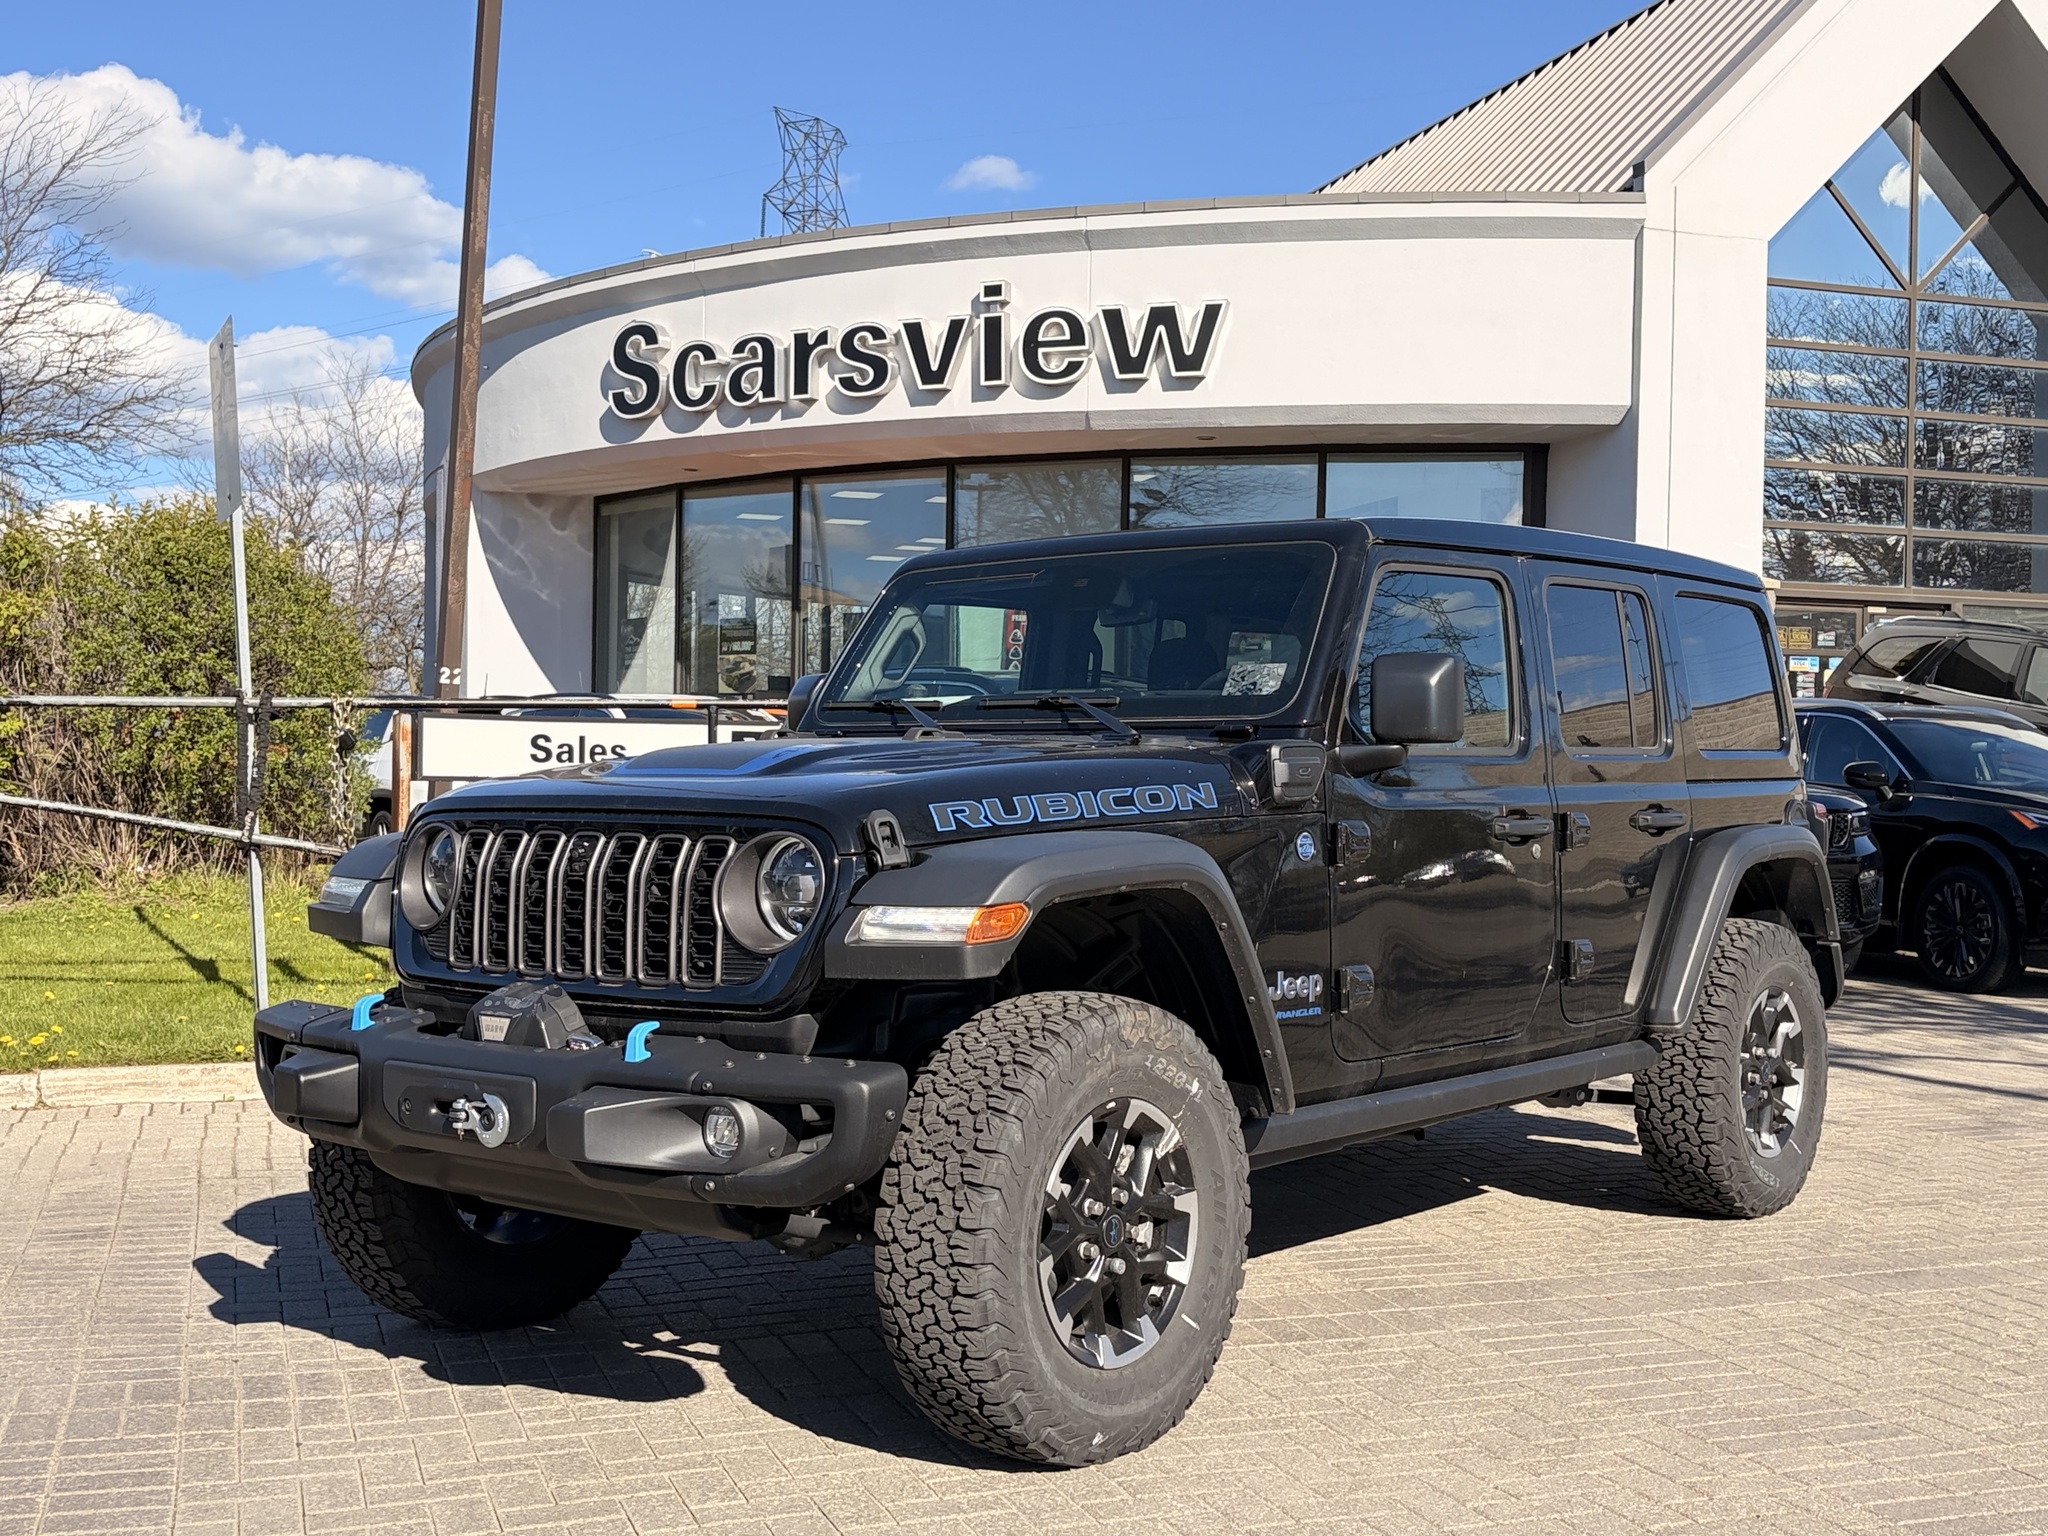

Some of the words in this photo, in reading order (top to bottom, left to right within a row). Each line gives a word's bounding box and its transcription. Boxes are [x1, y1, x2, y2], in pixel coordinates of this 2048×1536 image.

[609, 280, 1230, 419] Scarsview
[529, 733, 627, 764] Sales
[928, 782, 1218, 832] RUBICON
[1268, 970, 1324, 1003] Jeep
